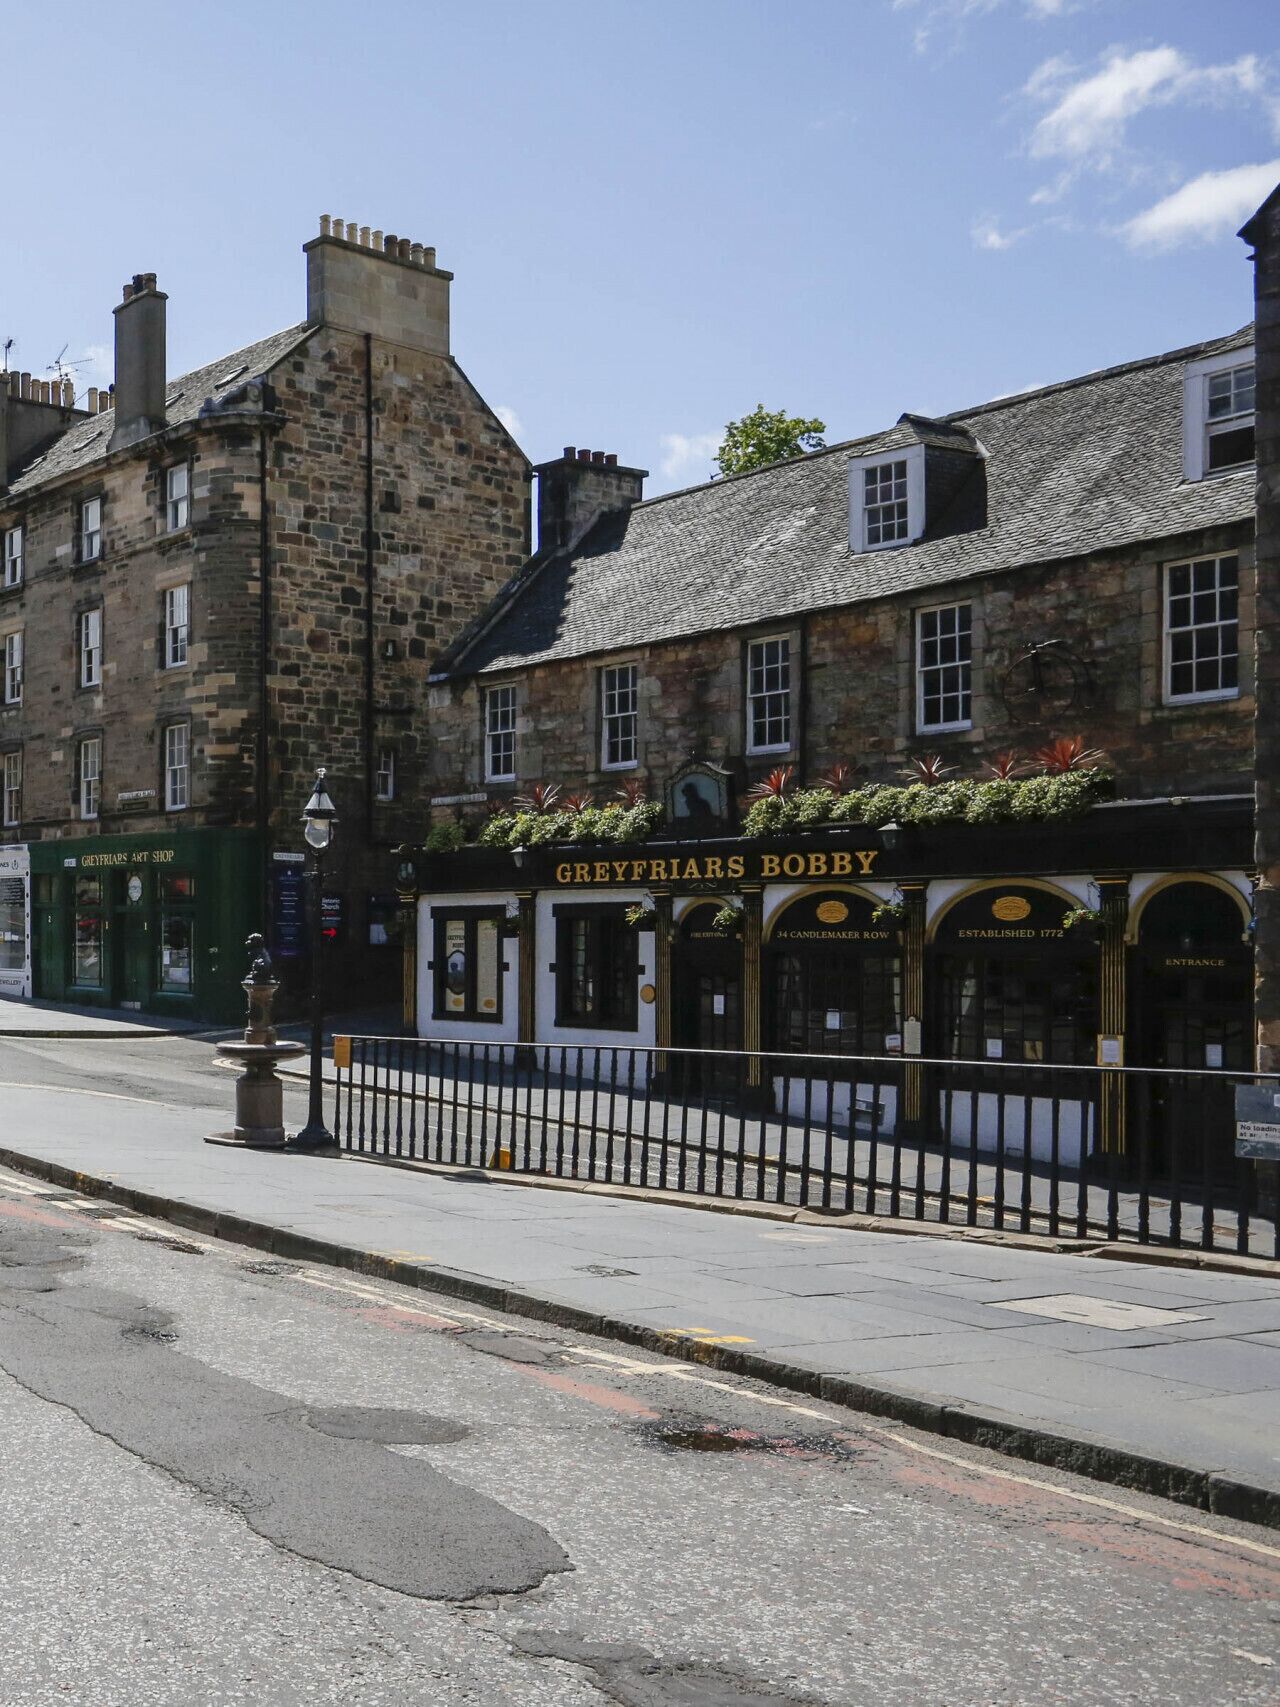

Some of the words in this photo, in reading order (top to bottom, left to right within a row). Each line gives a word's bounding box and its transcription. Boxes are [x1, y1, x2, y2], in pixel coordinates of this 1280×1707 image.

[81, 852, 128, 867] GREYFRIARS
[131, 851, 149, 863] ART
[152, 850, 174, 863] SHOP
[556, 855, 745, 884] GREYFRIARS
[760, 850, 879, 878] BOBBY
[776, 931, 788, 939] 34
[790, 931, 860, 939] CANDLEMAKER
[862, 931, 890, 939] ROW
[959, 929, 1035, 938] ESTABLISHED
[1040, 929, 1064, 938] 1772
[1166, 958, 1225, 967] ENTRANCE
